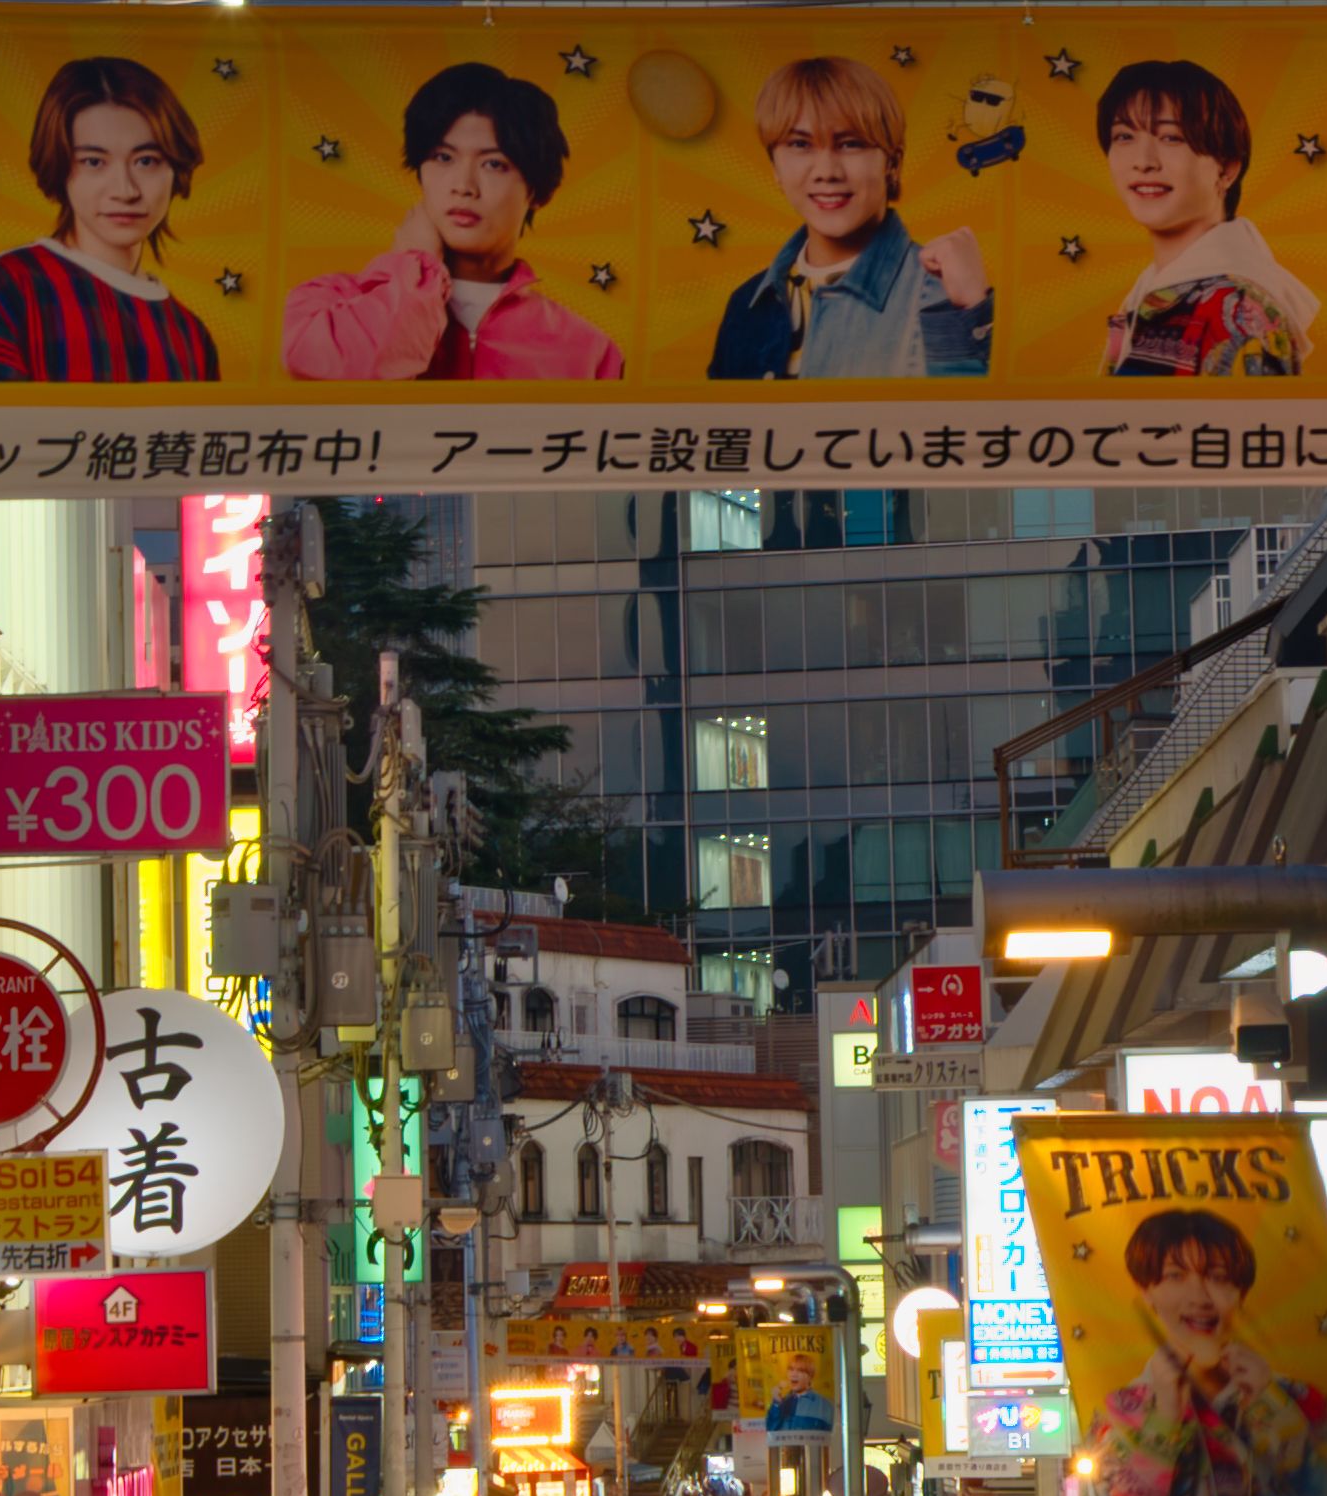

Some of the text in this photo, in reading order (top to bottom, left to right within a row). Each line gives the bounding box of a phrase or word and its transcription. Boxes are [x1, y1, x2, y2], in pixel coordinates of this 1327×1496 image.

[8, 713, 107, 754] PARIS
[114, 718, 203, 752] KID'S
[6, 764, 202, 842] ¥300
[107, 1007, 204, 1235] 古着
[54, 1161, 101, 1188] 54
[1051, 1147, 1292, 1219] TRICKS
[108, 1300, 134, 1318] 4F
[972, 1302, 1055, 1325] MONEY
[769, 1333, 826, 1355] TRICKS
[973, 1324, 1059, 1341] EXCHANGE
[1007, 1432, 1030, 1449] B1
